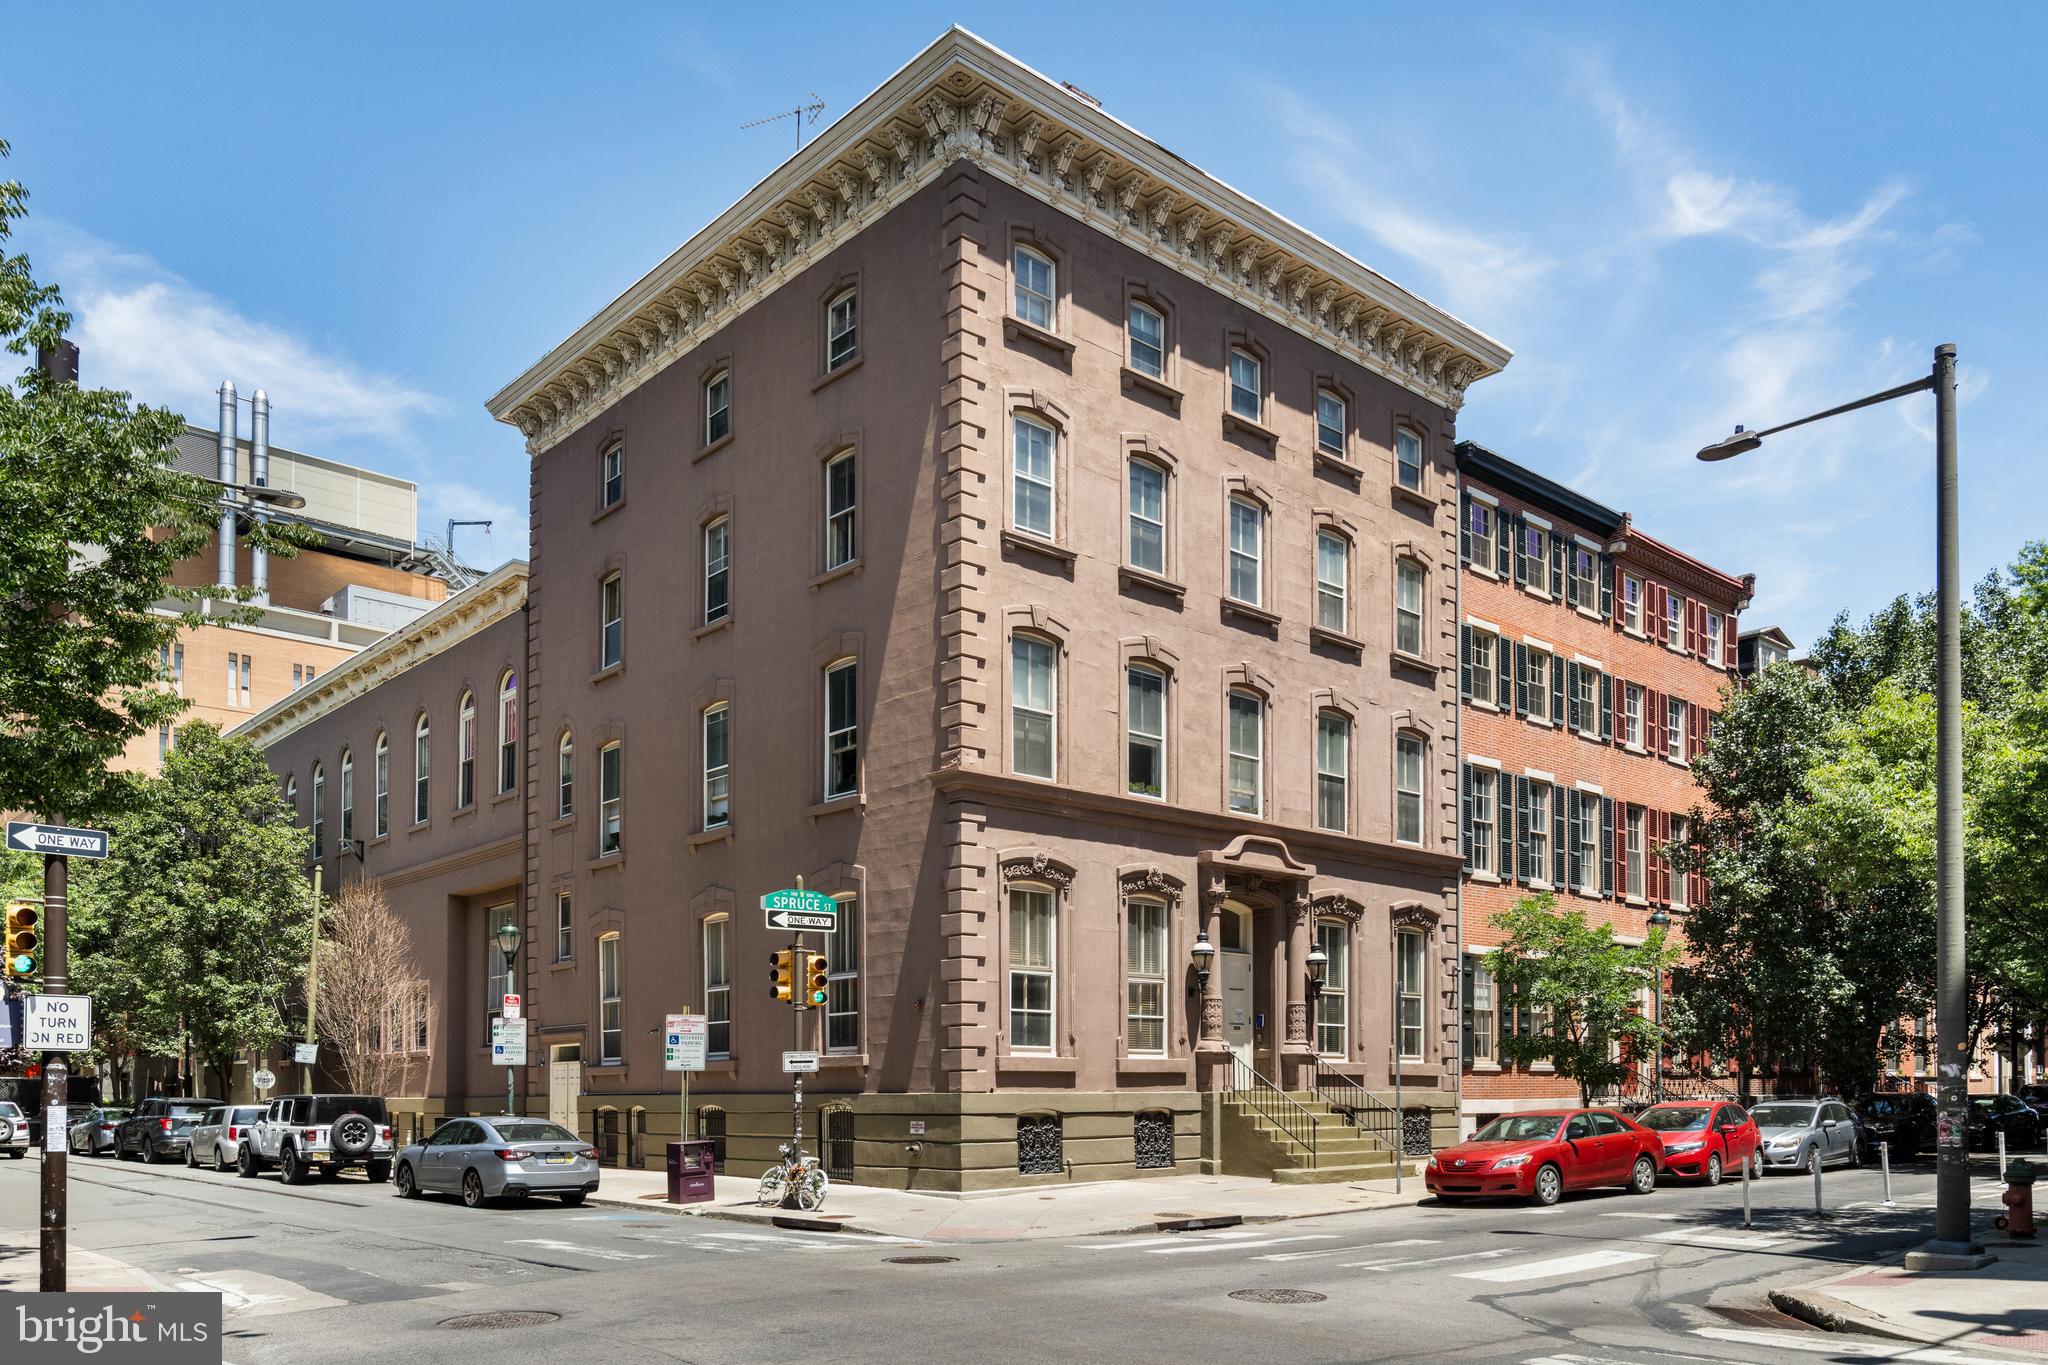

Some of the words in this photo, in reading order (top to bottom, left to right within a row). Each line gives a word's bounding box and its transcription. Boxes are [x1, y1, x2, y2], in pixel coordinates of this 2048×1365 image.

[38, 833, 65, 847] ONE
[69, 836, 96, 849] WAY
[773, 896, 820, 911] SPRUCE
[823, 903, 831, 911] ST
[787, 916, 806, 925] ONE
[808, 917, 828, 926] WAY
[47, 1002, 69, 1013] NO
[39, 1017, 77, 1028] TURN
[56, 1033, 84, 1044] RED
